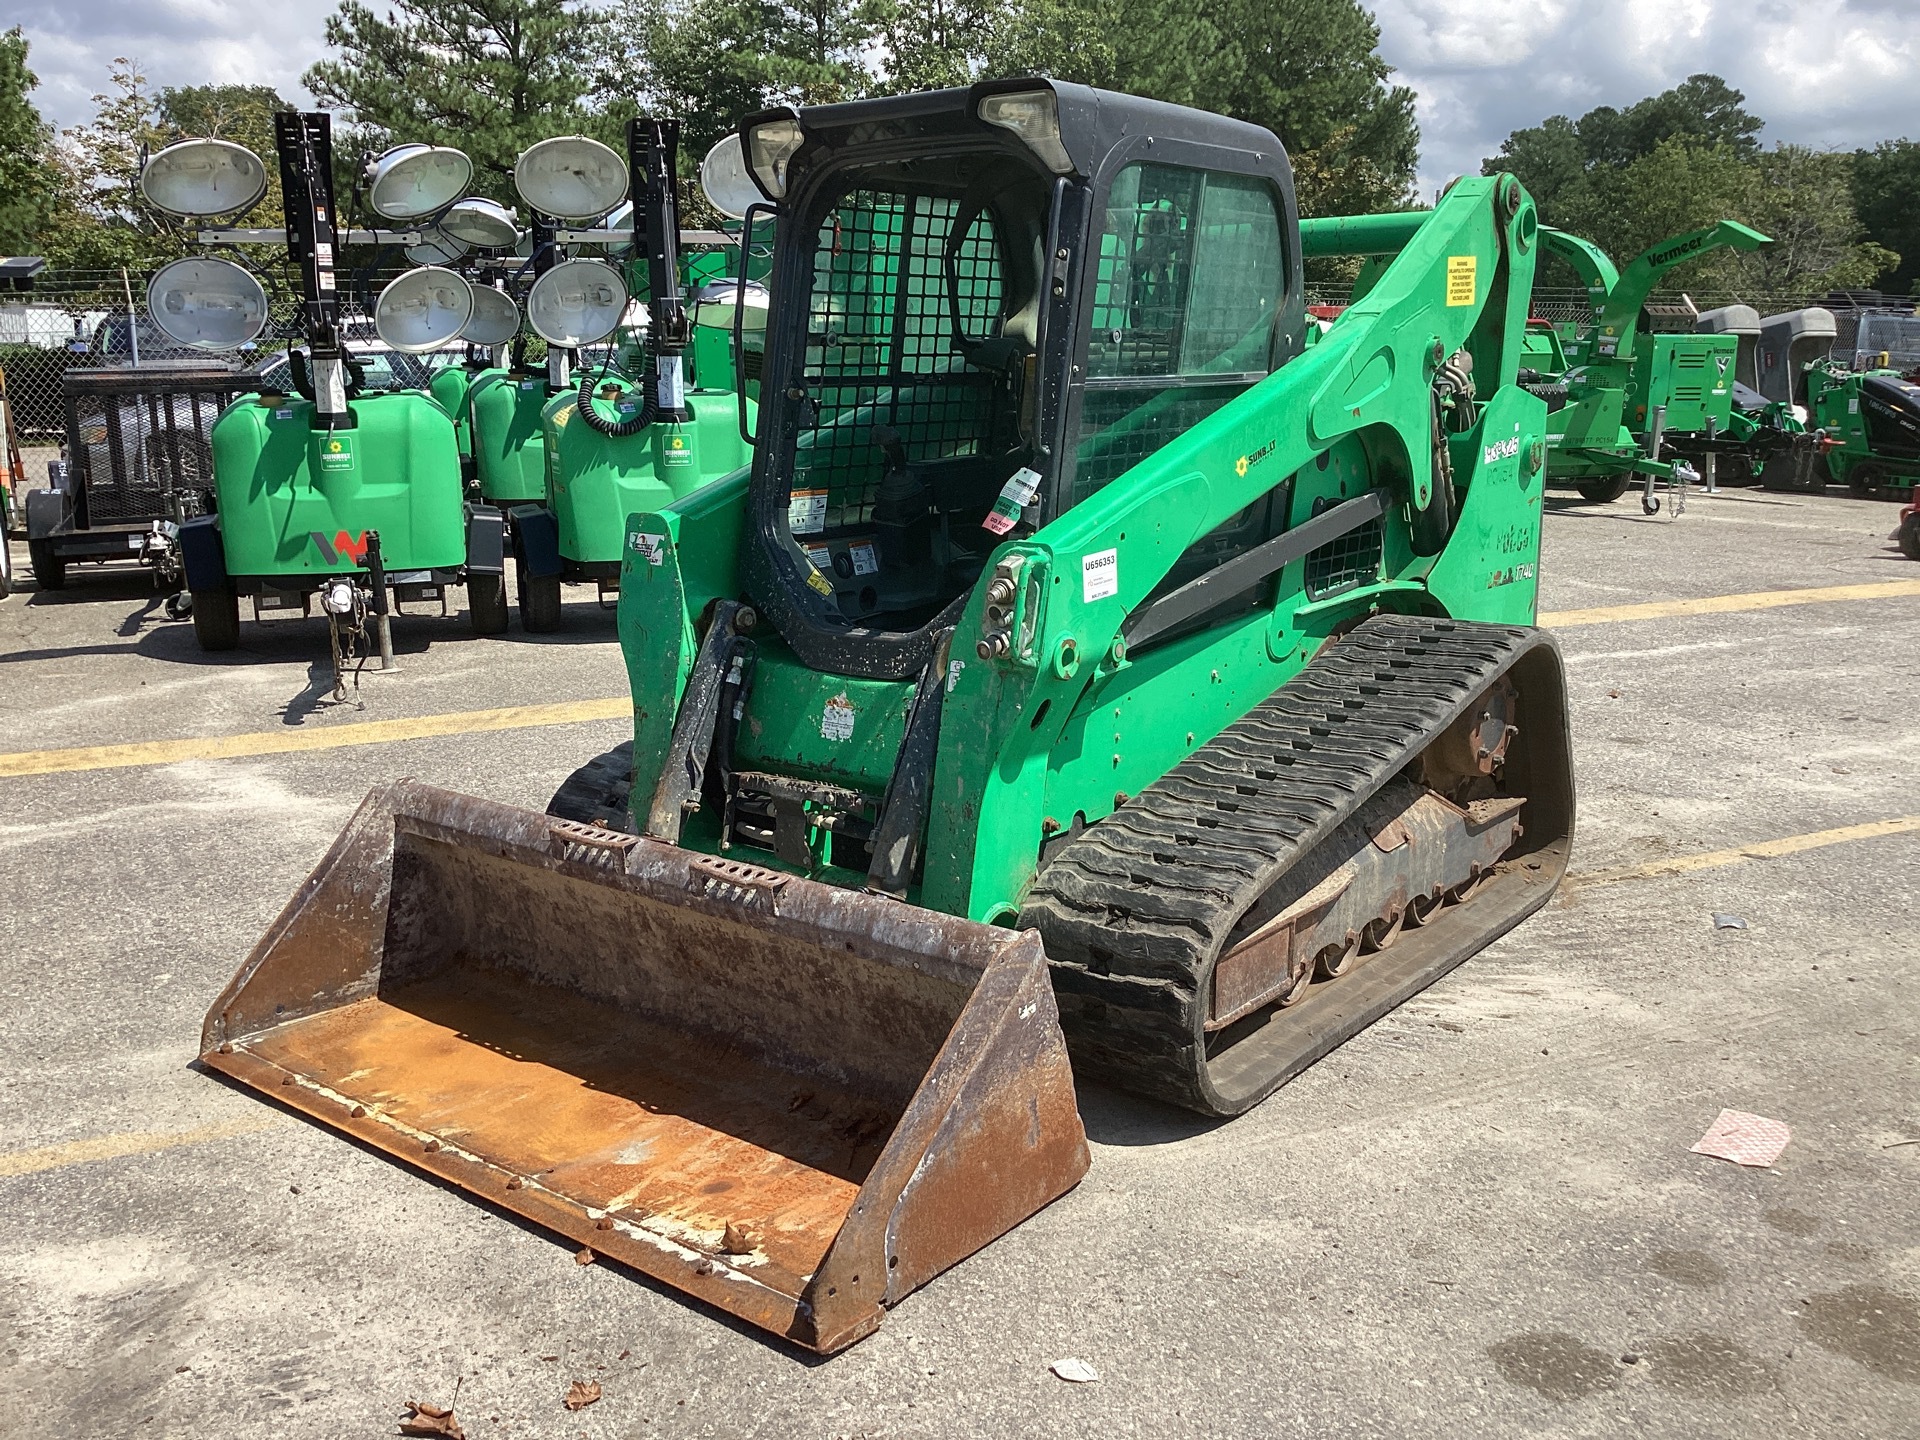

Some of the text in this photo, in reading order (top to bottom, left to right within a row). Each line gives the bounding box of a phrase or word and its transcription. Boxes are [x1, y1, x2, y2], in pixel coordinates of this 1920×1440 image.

[1549, 239, 1573, 256] Vermeer
[1647, 236, 1702, 267] Vermeer
[1248, 439, 1276, 466] SUNBLT
[998, 501, 1012, 511] READY
[991, 524, 1003, 532] USE
[997, 520, 1009, 528] NOT
[1085, 555, 1115, 571] U656353
